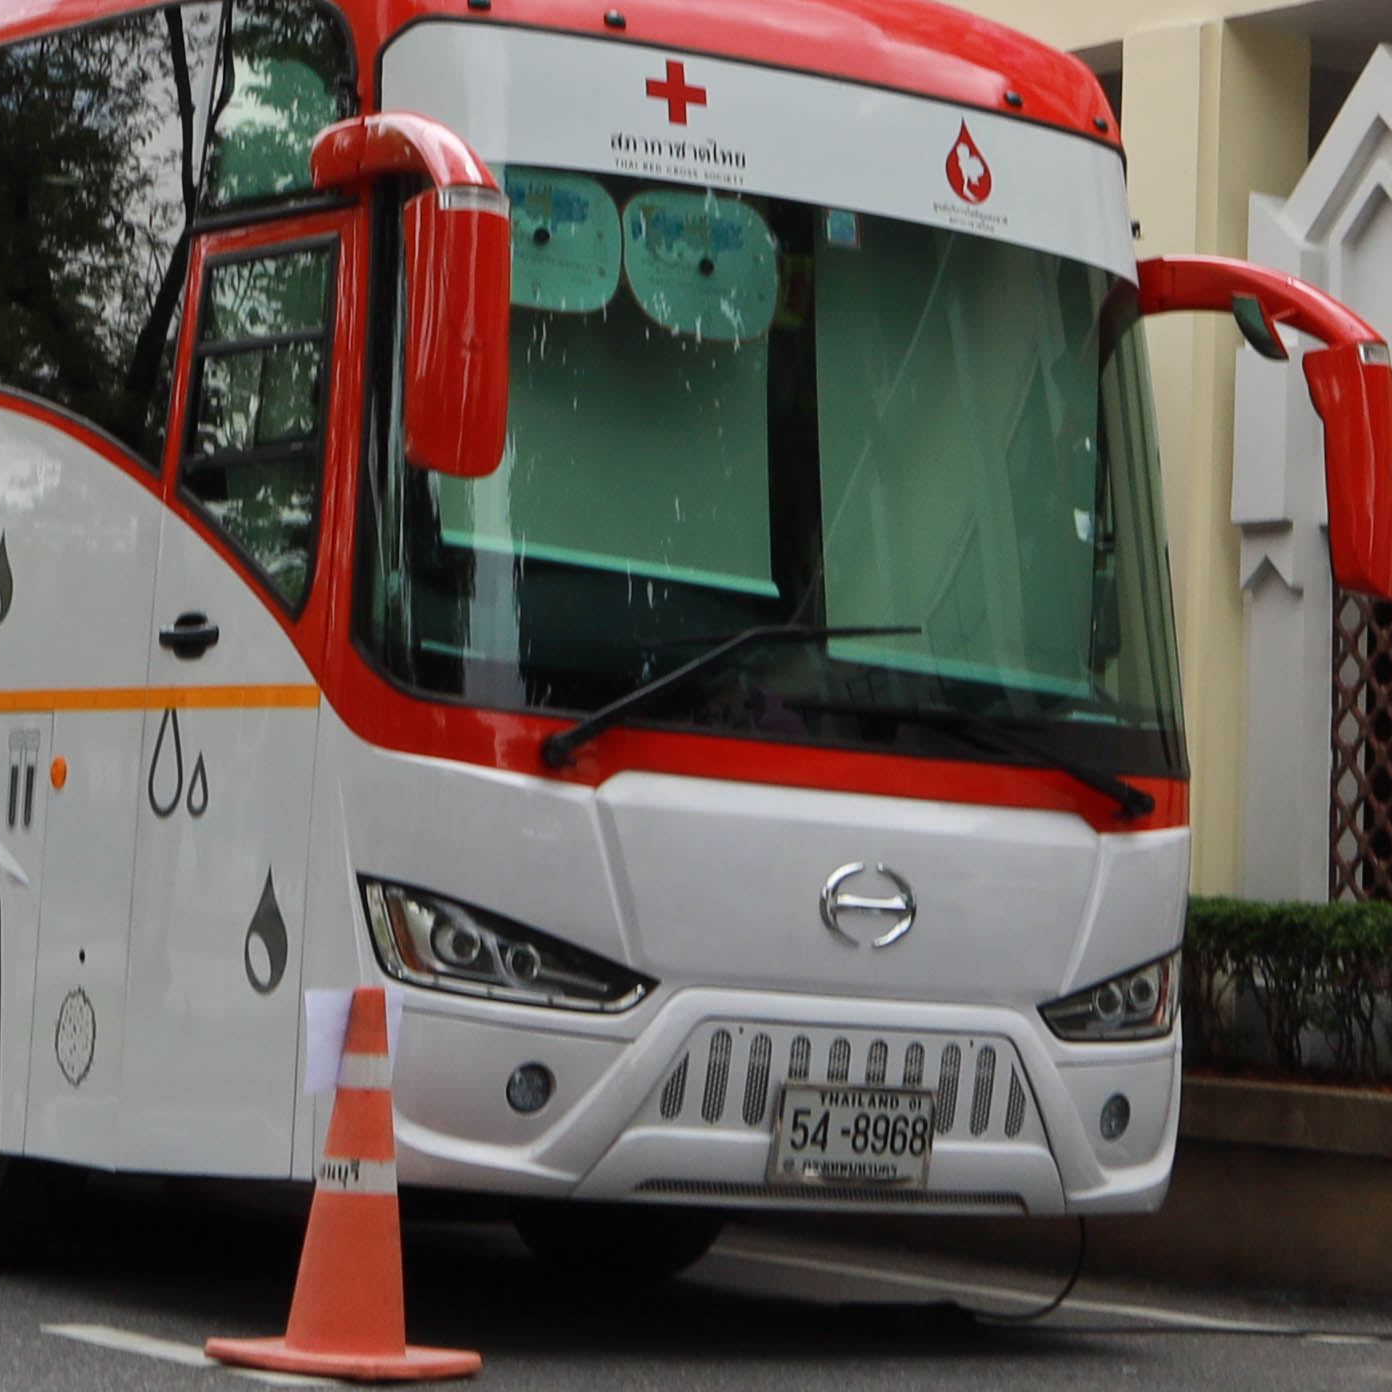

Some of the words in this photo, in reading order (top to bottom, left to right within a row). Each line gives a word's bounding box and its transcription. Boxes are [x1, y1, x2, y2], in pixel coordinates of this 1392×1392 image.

[611, 133, 746, 169] สภากาชาดไทย
[615, 159, 638, 170] THAI
[643, 163, 662, 173] RED
[819, 1091, 900, 1110] THAILAND
